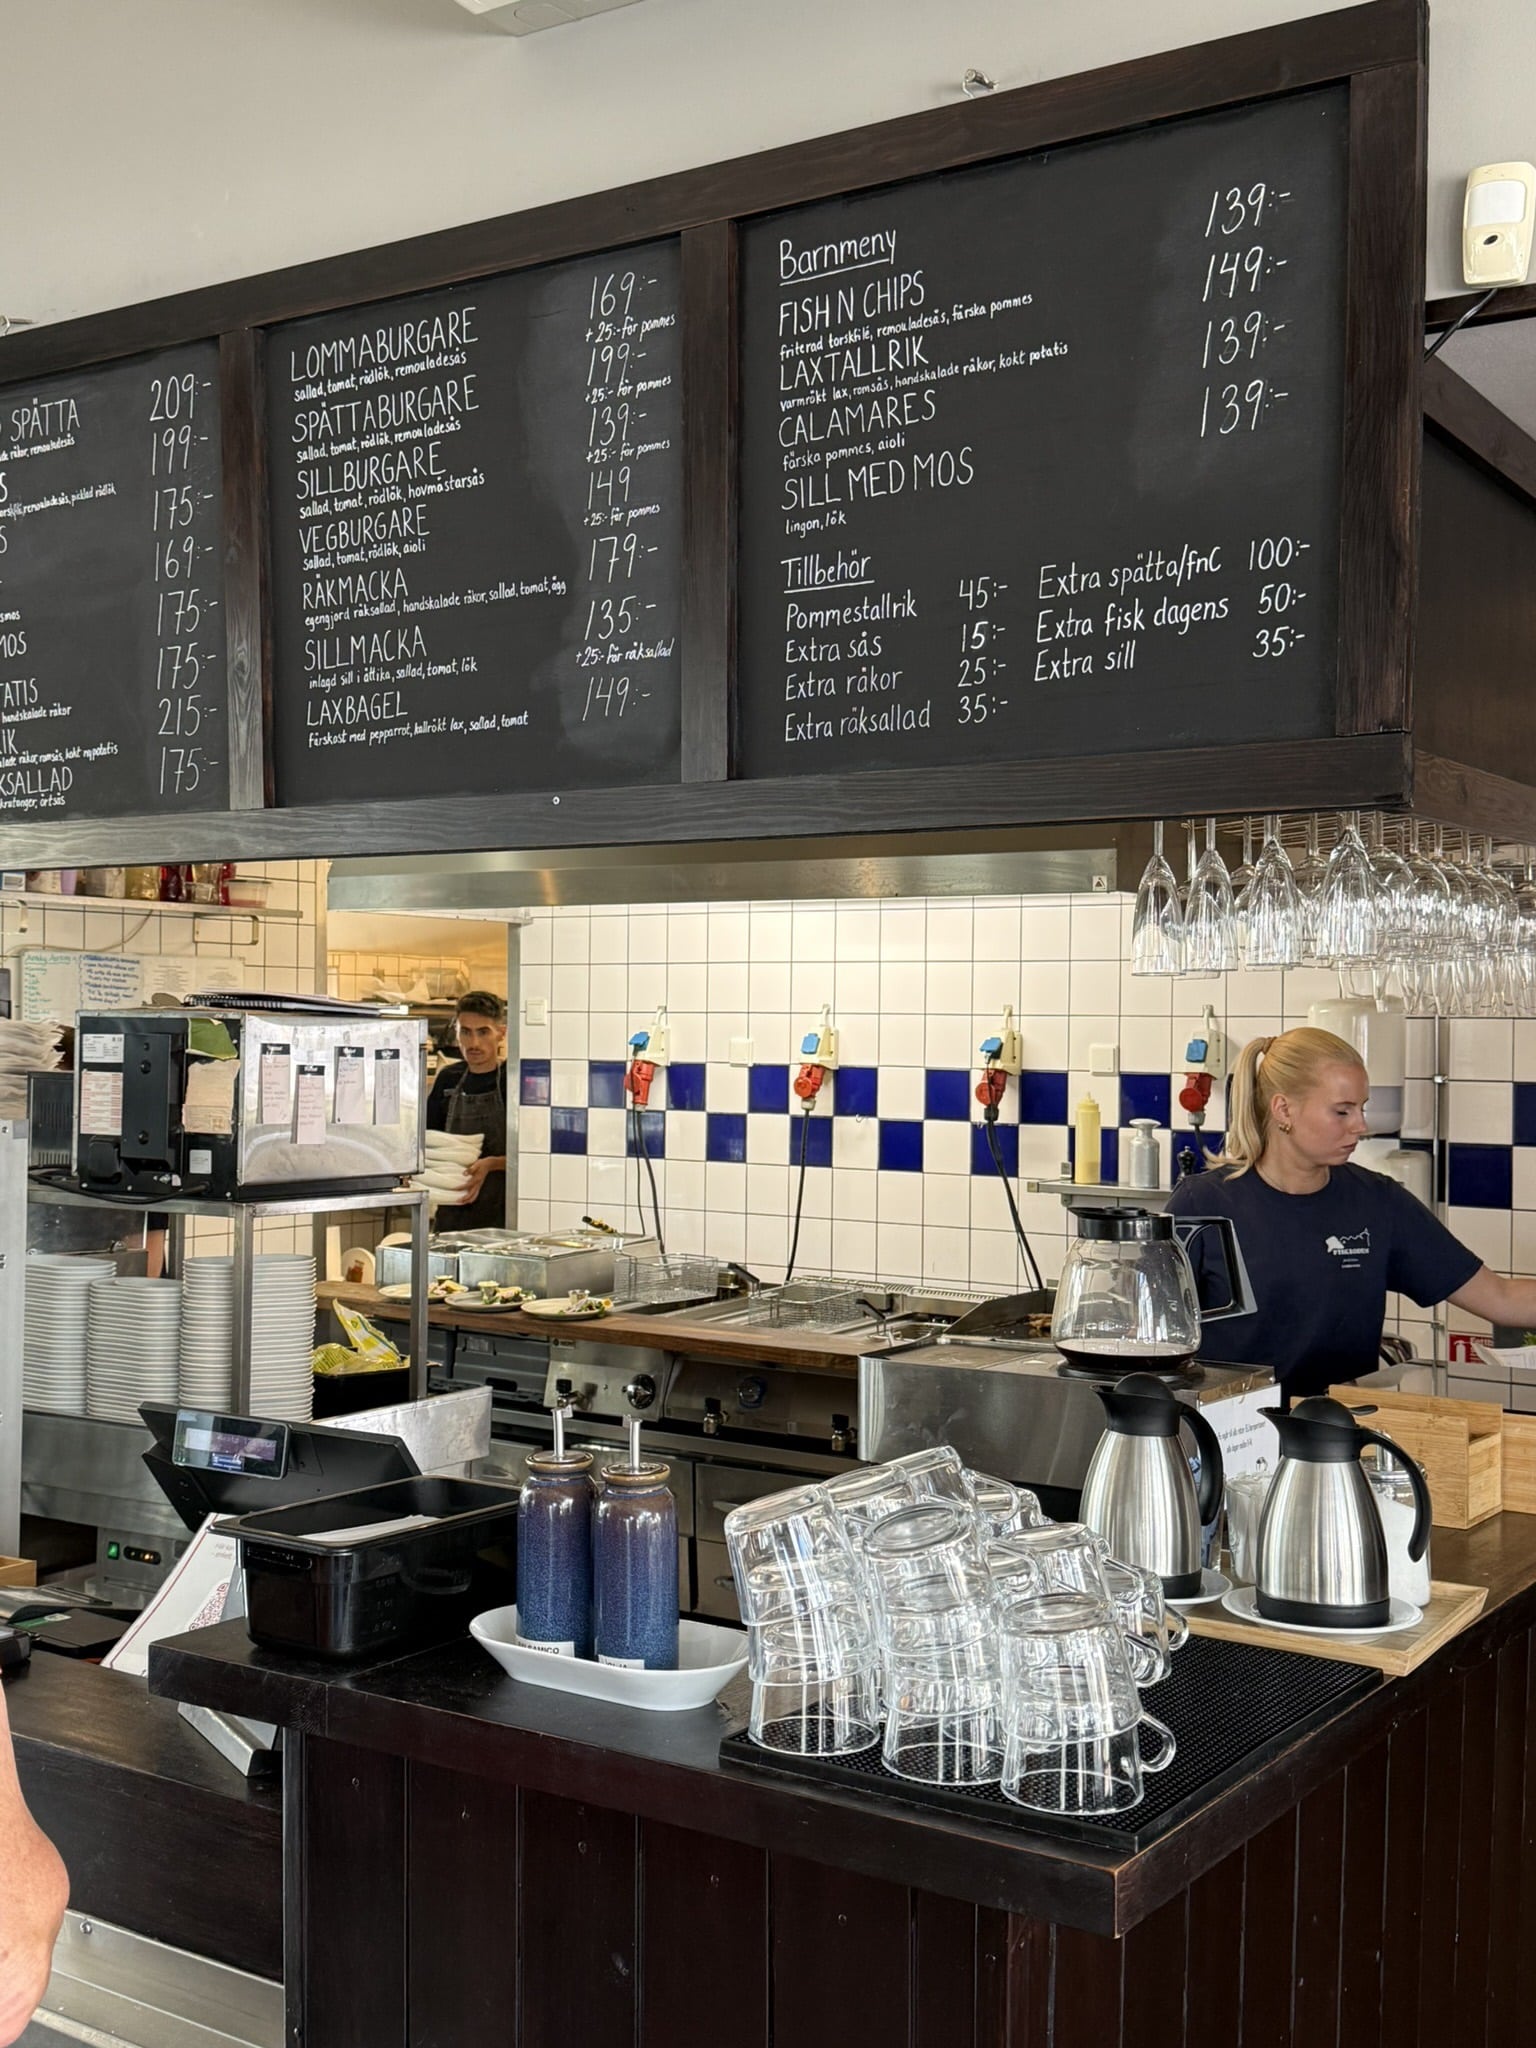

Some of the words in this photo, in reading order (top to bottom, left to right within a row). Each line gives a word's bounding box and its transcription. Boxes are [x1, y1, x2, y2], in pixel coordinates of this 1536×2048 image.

[1204, 182, 1291, 238] 139:-
[779, 229, 896, 280] Barnmeny
[1202, 245, 1288, 303] 149:-
[589, 271, 657, 320] 169:-
[779, 294, 830, 337] FISH
[837, 287, 854, 325] N
[863, 270, 925, 319] CHIPS
[291, 306, 479, 382] LOMMABURGARE
[639, 314, 676, 343] pommes
[779, 336, 824, 361] friterad
[876, 308, 950, 338] remouladesås,
[952, 304, 988, 322] färska
[990, 293, 1033, 319] pommes
[1202, 311, 1286, 369] 139:-
[294, 381, 327, 402] sallad,
[327, 373, 358, 394] tomat,
[395, 347, 467, 378] remouladesås
[586, 342, 647, 386] 199:-
[780, 335, 929, 391] LAXTALLRIK
[780, 390, 827, 412] varmrökt
[832, 386, 852, 401] lax,
[853, 376, 894, 397] romsås,
[895, 363, 960, 388] handskalade
[963, 357, 997, 377] räkor,
[999, 350, 1026, 370] kokt
[1029, 340, 1069, 366] potatis
[150, 373, 212, 421] 209:-
[291, 374, 480, 443] SPÄTTABURGARE
[635, 375, 673, 400] pommes
[1200, 379, 1289, 438] 139:-
[10, 397, 80, 441] SPÄTTA
[296, 445, 329, 464] sallad,
[394, 415, 462, 442] remouladesås
[589, 402, 648, 447] 139:-
[778, 389, 937, 448] CALAMARES
[152, 424, 209, 475] 199:-
[296, 441, 447, 500] SILLBURGARE
[619, 443, 636, 462] för
[636, 439, 671, 460] pommes
[782, 451, 822, 472] färska
[825, 438, 875, 469] pommes,
[878, 431, 906, 451] aioli
[781, 473, 842, 511] SILL
[848, 459, 905, 502] MED
[913, 446, 975, 491] MOS
[153, 486, 214, 531] 175:-
[299, 499, 333, 519] sallad,
[334, 491, 368, 512] tomat,
[609, 506, 625, 526] för
[626, 504, 661, 527] pommes
[785, 516, 824, 538] lingon,
[825, 510, 847, 529] lök
[299, 503, 430, 554] VEGBURGARE
[155, 536, 214, 581] 169:-
[303, 553, 335, 571] sallad,
[336, 547, 369, 564] tomat,
[403, 538, 426, 552] aioli
[588, 533, 659, 584] 179:-
[781, 548, 872, 588] Tillbehör
[1249, 536, 1311, 571] 100:-
[303, 567, 409, 610] RÄKMACKA
[958, 576, 1008, 611] 45:-
[1038, 561, 1101, 600] Extra
[1257, 583, 1307, 614] 50:-
[158, 589, 218, 636] 175:-
[304, 603, 350, 632] egengjord
[403, 592, 461, 613] handskalade
[489, 581, 519, 601] sallad,
[520, 576, 551, 595] tomat,
[551, 576, 567, 595] ägg
[584, 595, 657, 641] 135:-
[786, 588, 917, 632] Pommestallrik
[1036, 608, 1094, 643] Extra
[1105, 597, 1146, 637] fisk
[1153, 596, 1229, 636] dagens
[304, 625, 427, 672] SILLMACKA
[605, 643, 623, 664] för
[624, 637, 676, 662] räksallad
[786, 637, 841, 664] Extra
[847, 631, 883, 659] sås
[961, 620, 1006, 653] 15:-
[1252, 626, 1306, 658] 35:-
[157, 642, 217, 690] 175:-
[309, 673, 337, 693] inlagd
[340, 670, 354, 687] sill
[356, 668, 361, 684] i
[396, 664, 425, 680] sallad,
[427, 658, 460, 676] tomat,
[461, 655, 478, 673] lök
[957, 656, 1007, 688] 25:-
[1034, 647, 1094, 682] Extra
[1104, 639, 1137, 671] sill
[582, 676, 652, 722] 149:-
[786, 671, 836, 702] Extra
[847, 665, 904, 695] räkor
[158, 695, 218, 737] 215:-
[307, 690, 409, 727] LAXBAGEL
[349, 730, 366, 743] med
[450, 717, 468, 735] lax,
[469, 714, 500, 732] sallad,
[501, 710, 529, 728] tomat
[785, 711, 833, 743] Extra
[840, 700, 931, 737] räksallad
[958, 693, 1008, 724] 35:-
[160, 746, 219, 795] 175:-
